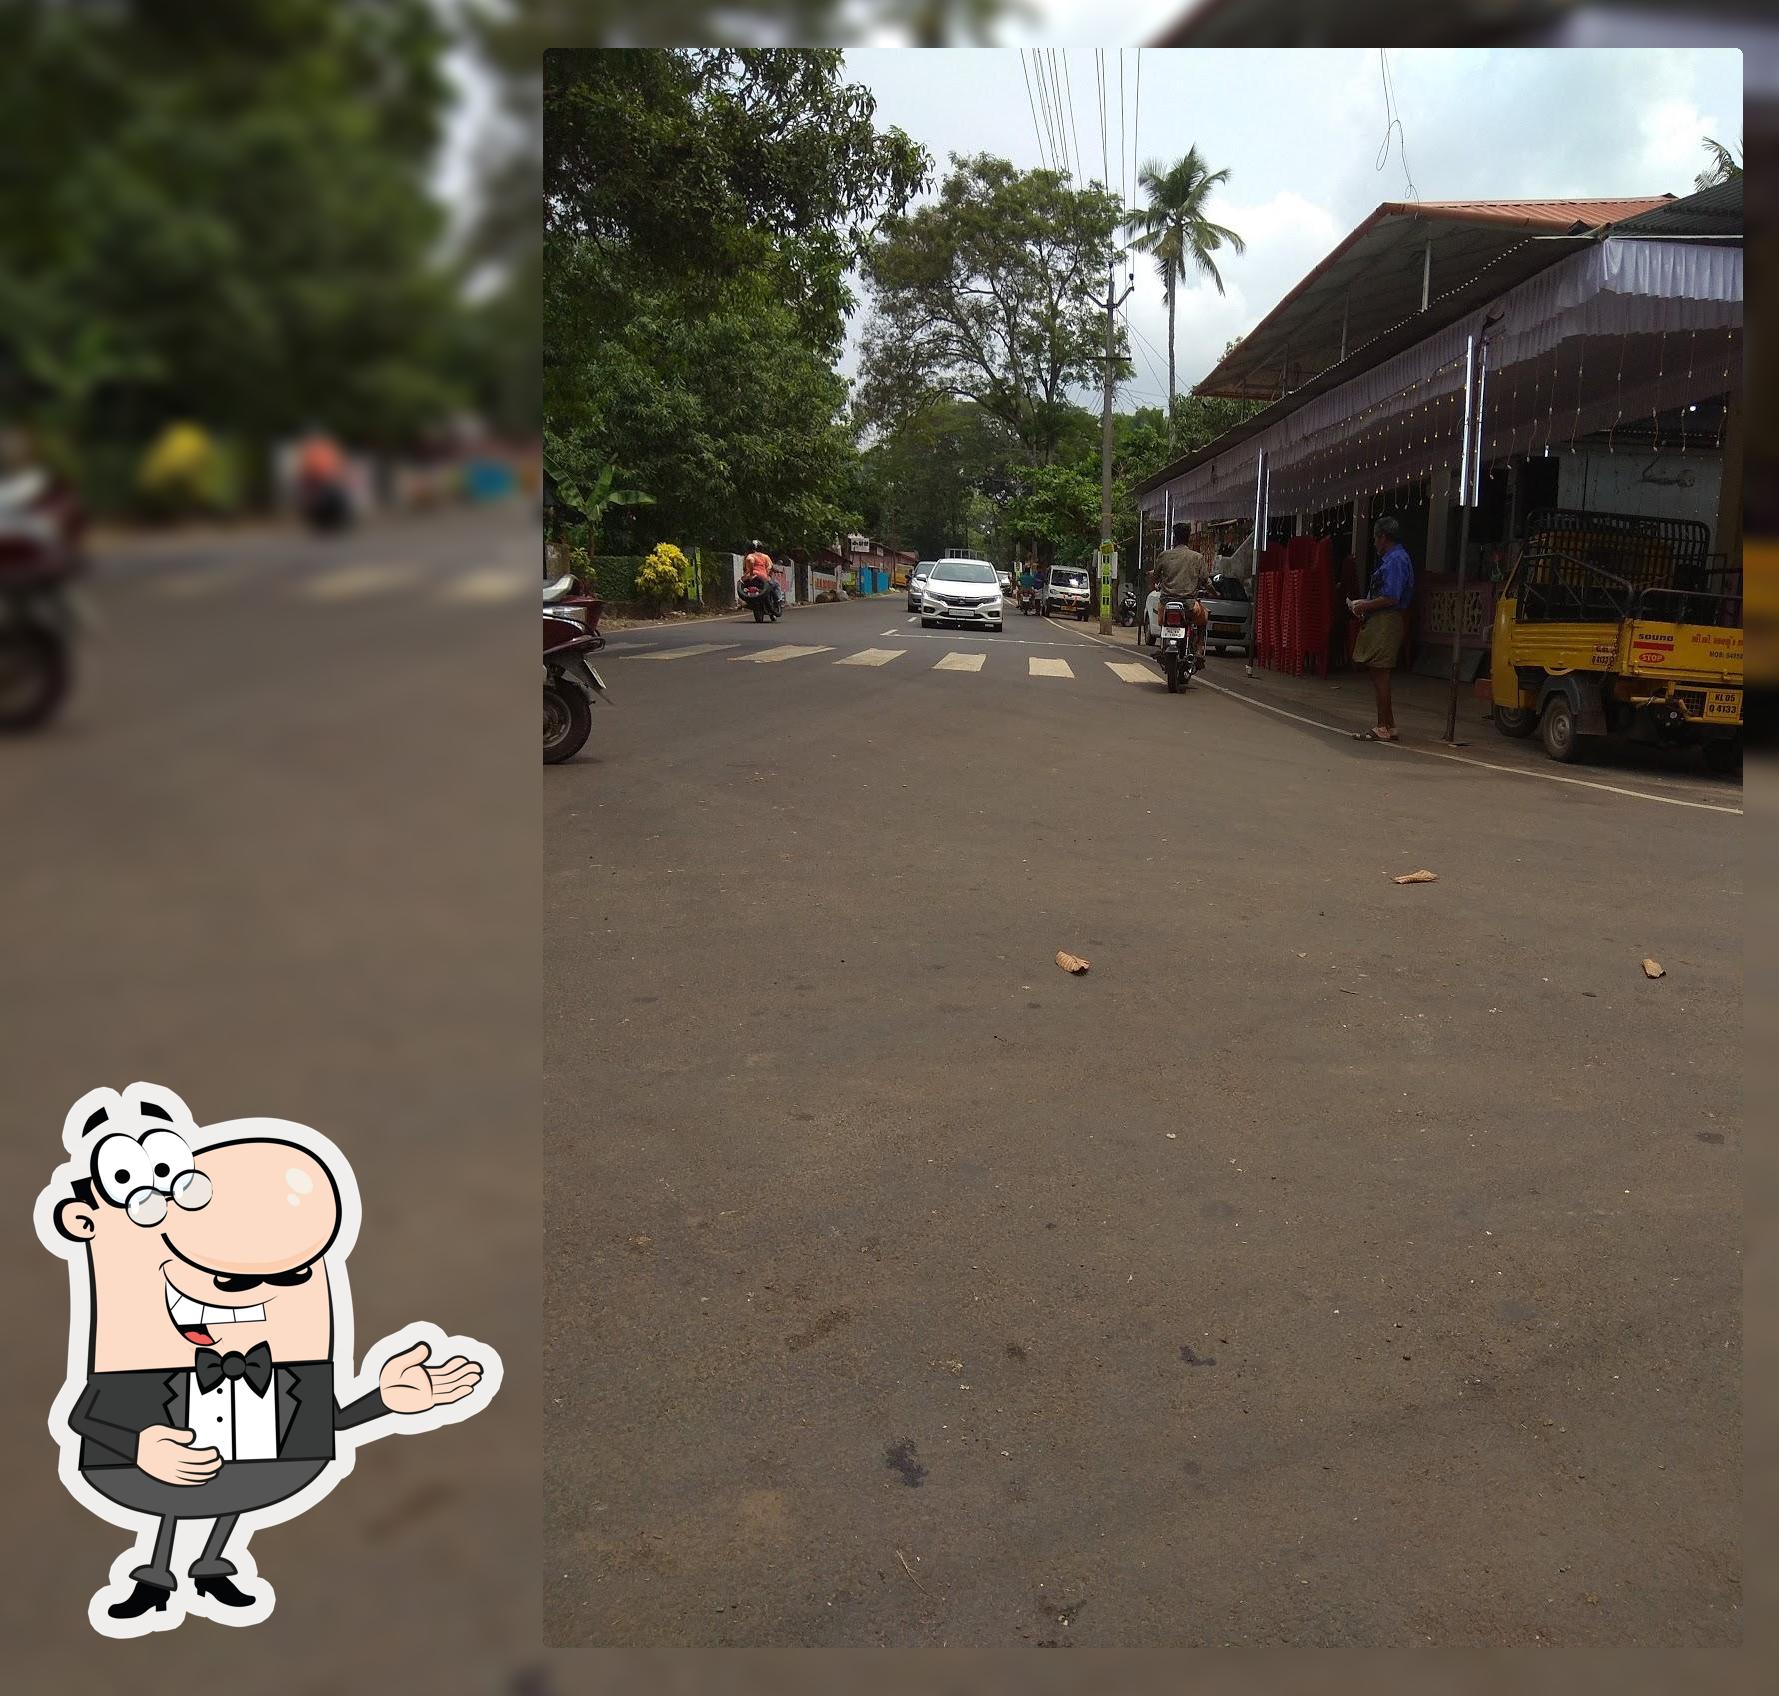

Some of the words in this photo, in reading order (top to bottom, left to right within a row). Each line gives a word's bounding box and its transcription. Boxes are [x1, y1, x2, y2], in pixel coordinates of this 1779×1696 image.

[1641, 653, 1663, 662] STOP
[1715, 693, 1724, 701] KL
[1725, 694, 1736, 702] 05
[1716, 704, 1737, 713] 4133
